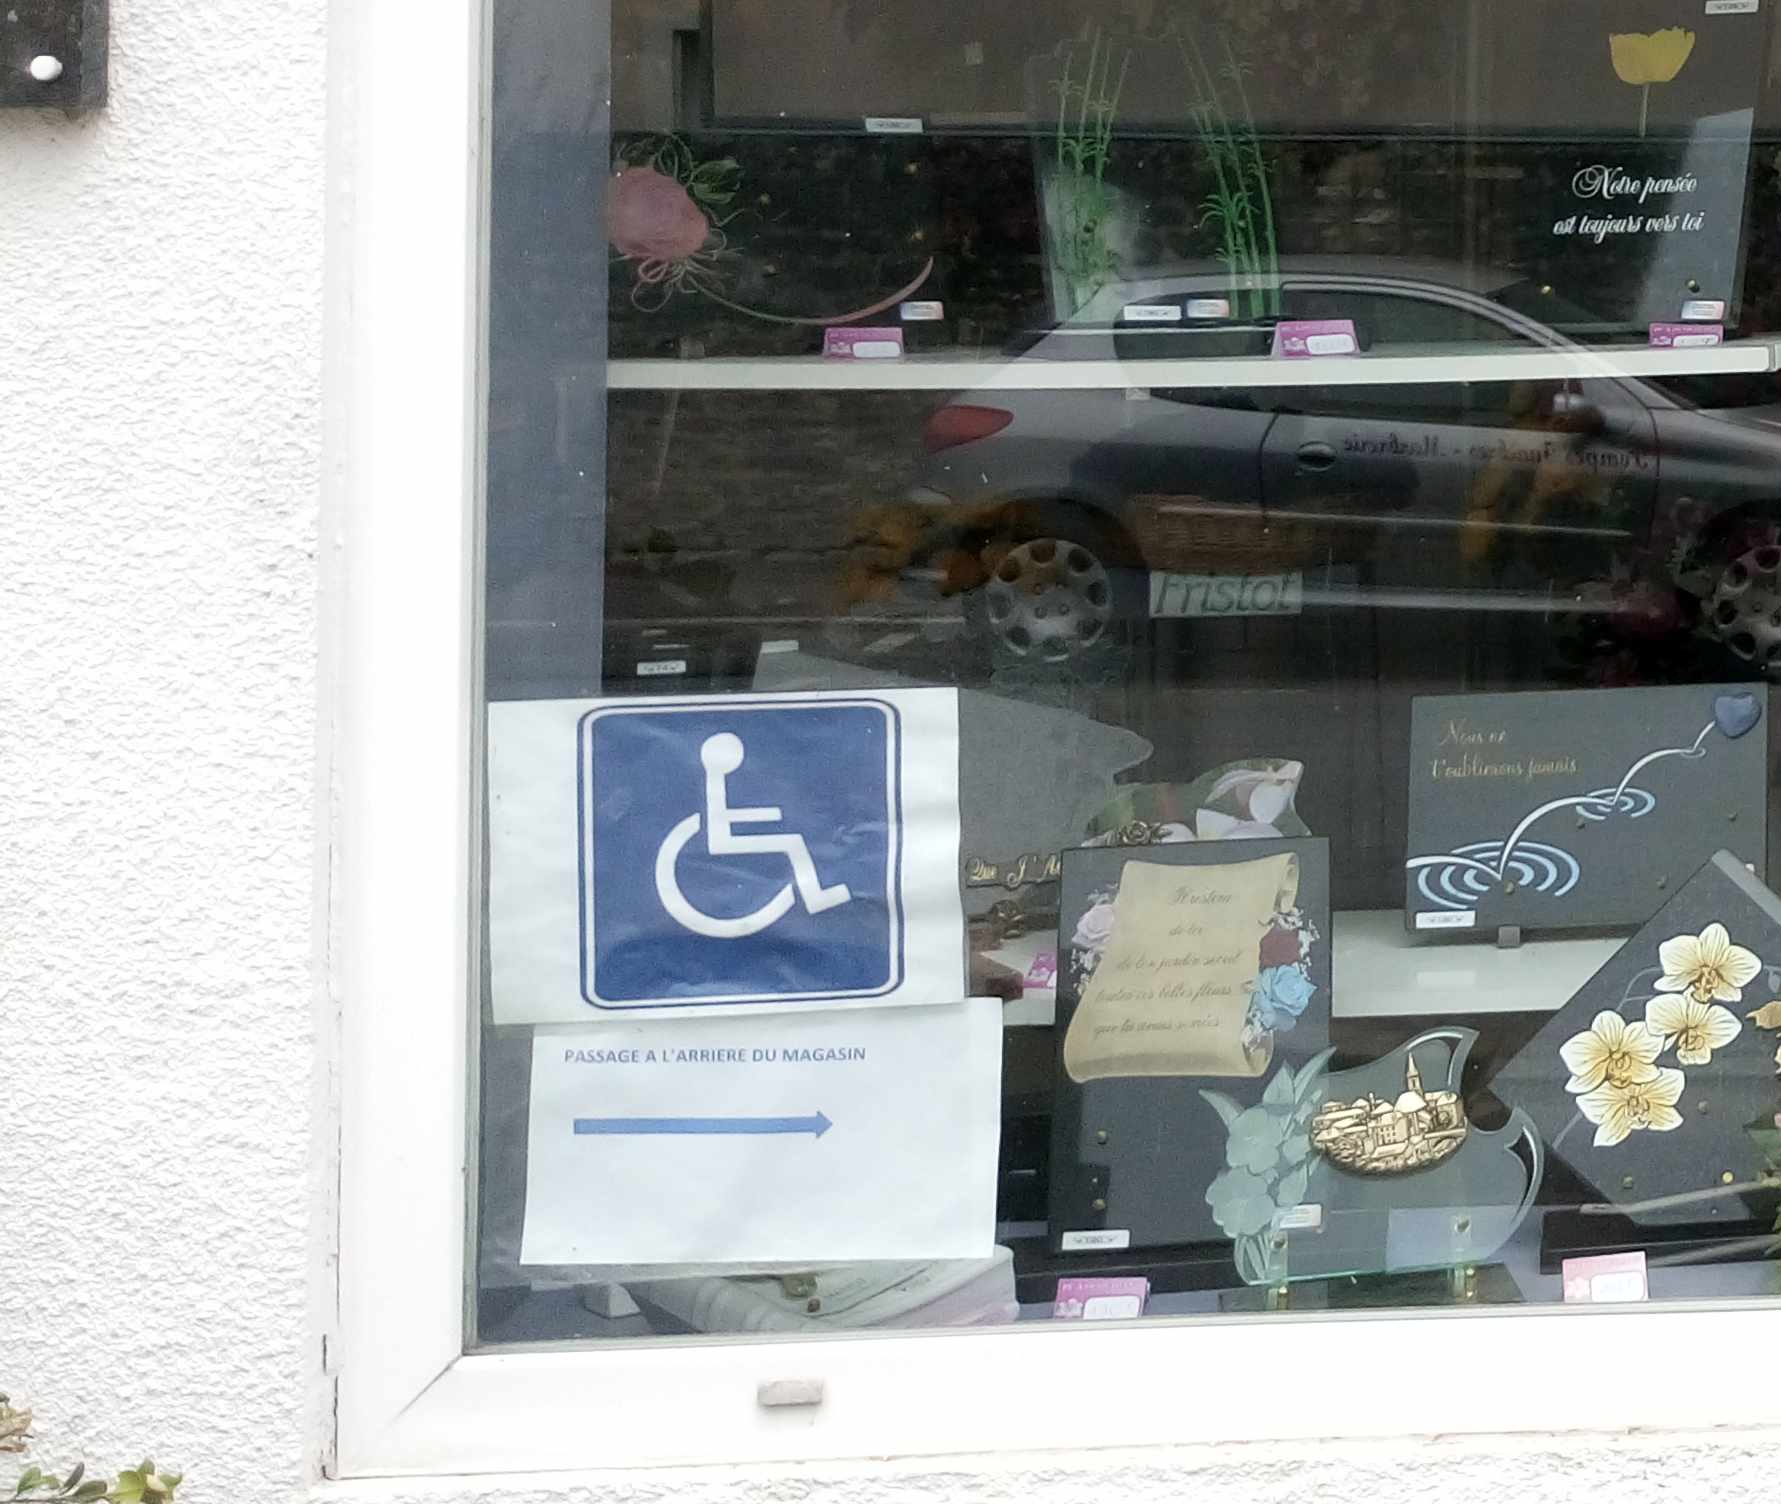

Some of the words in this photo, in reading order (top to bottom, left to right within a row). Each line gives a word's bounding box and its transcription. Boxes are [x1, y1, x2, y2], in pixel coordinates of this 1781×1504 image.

[1571, 164, 1641, 200] Notre
[1638, 171, 1697, 204] pensée
[1553, 215, 1577, 235] est
[1578, 214, 1644, 244] toujours
[1645, 213, 1680, 232] vers
[1681, 211, 1705, 232] toi
[563, 1047, 640, 1064] PASSAGE
[644, 1048, 658, 1063] A
[662, 1047, 747, 1063] L'ARRIERE
[751, 1047, 777, 1062] DU
[782, 1046, 867, 1062] MAGASIN
